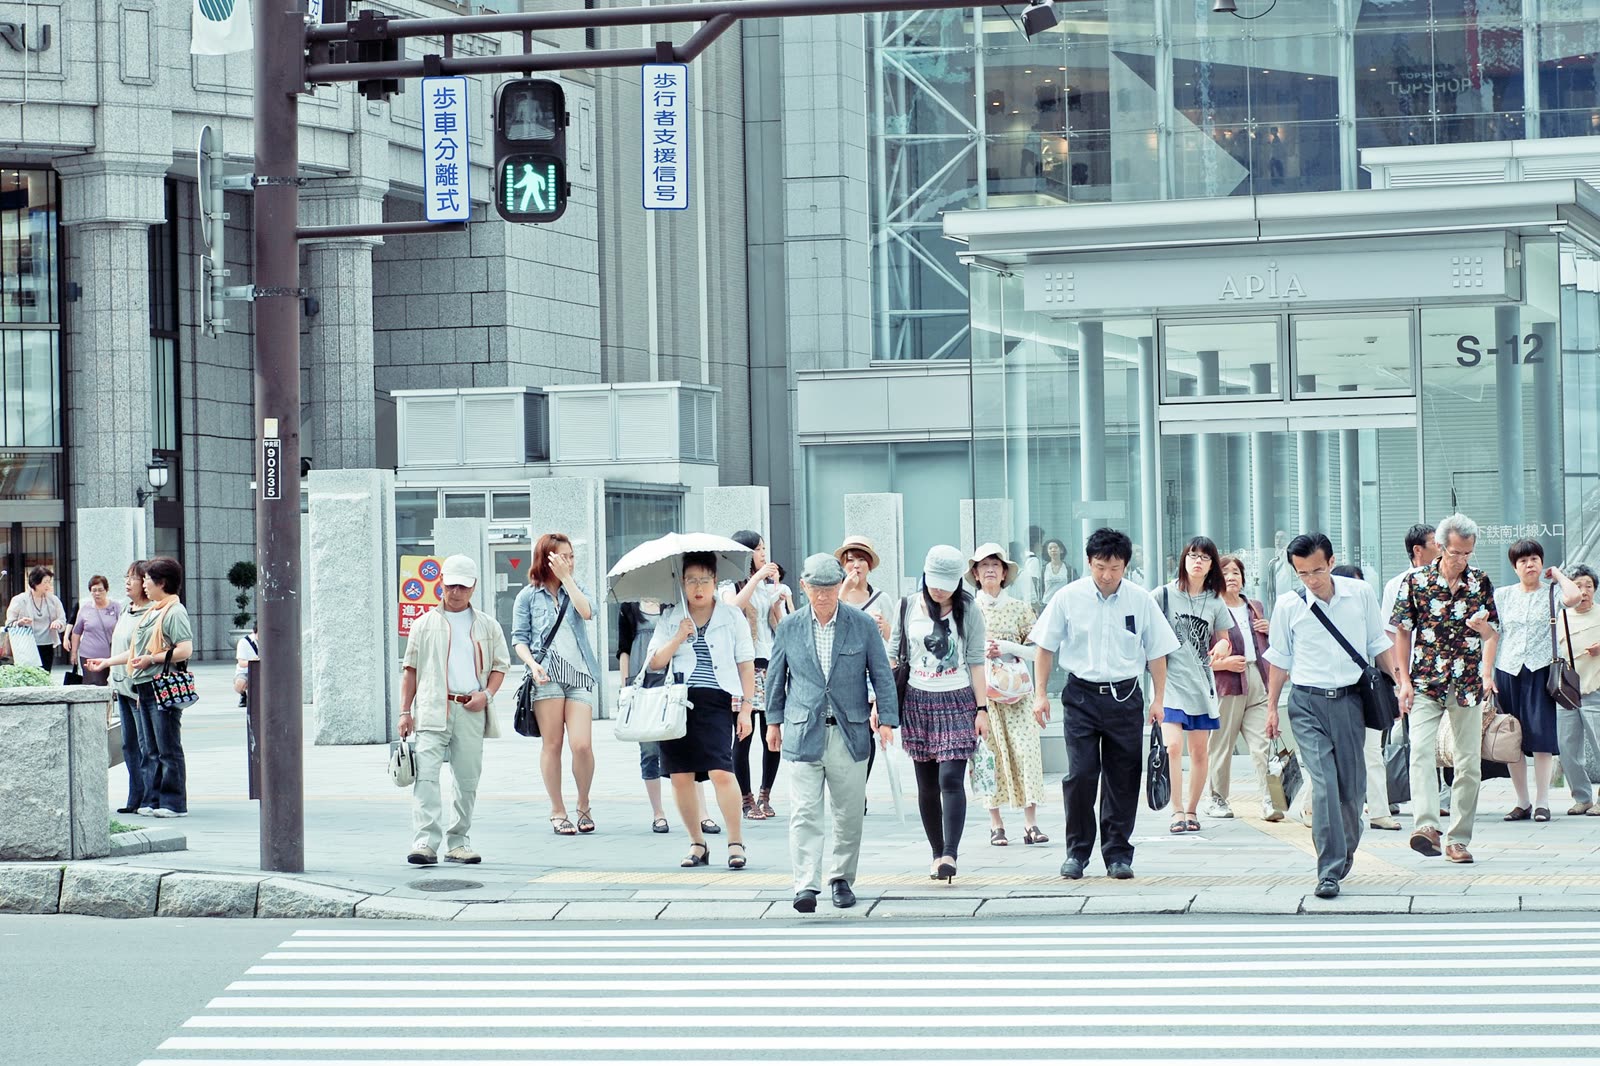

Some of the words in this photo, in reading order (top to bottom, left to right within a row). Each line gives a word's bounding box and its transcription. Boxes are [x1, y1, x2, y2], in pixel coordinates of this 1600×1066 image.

[1387, 78, 1472, 95] TOPSHOP
[433, 86, 460, 212] 歩車分離式
[653, 73, 677, 202] 歩行者支援信号
[1456, 333, 1545, 367] S-12
[267, 448, 276, 497] 90235
[402, 604, 437, 618] 進入
[944, 667, 958, 675] ME
